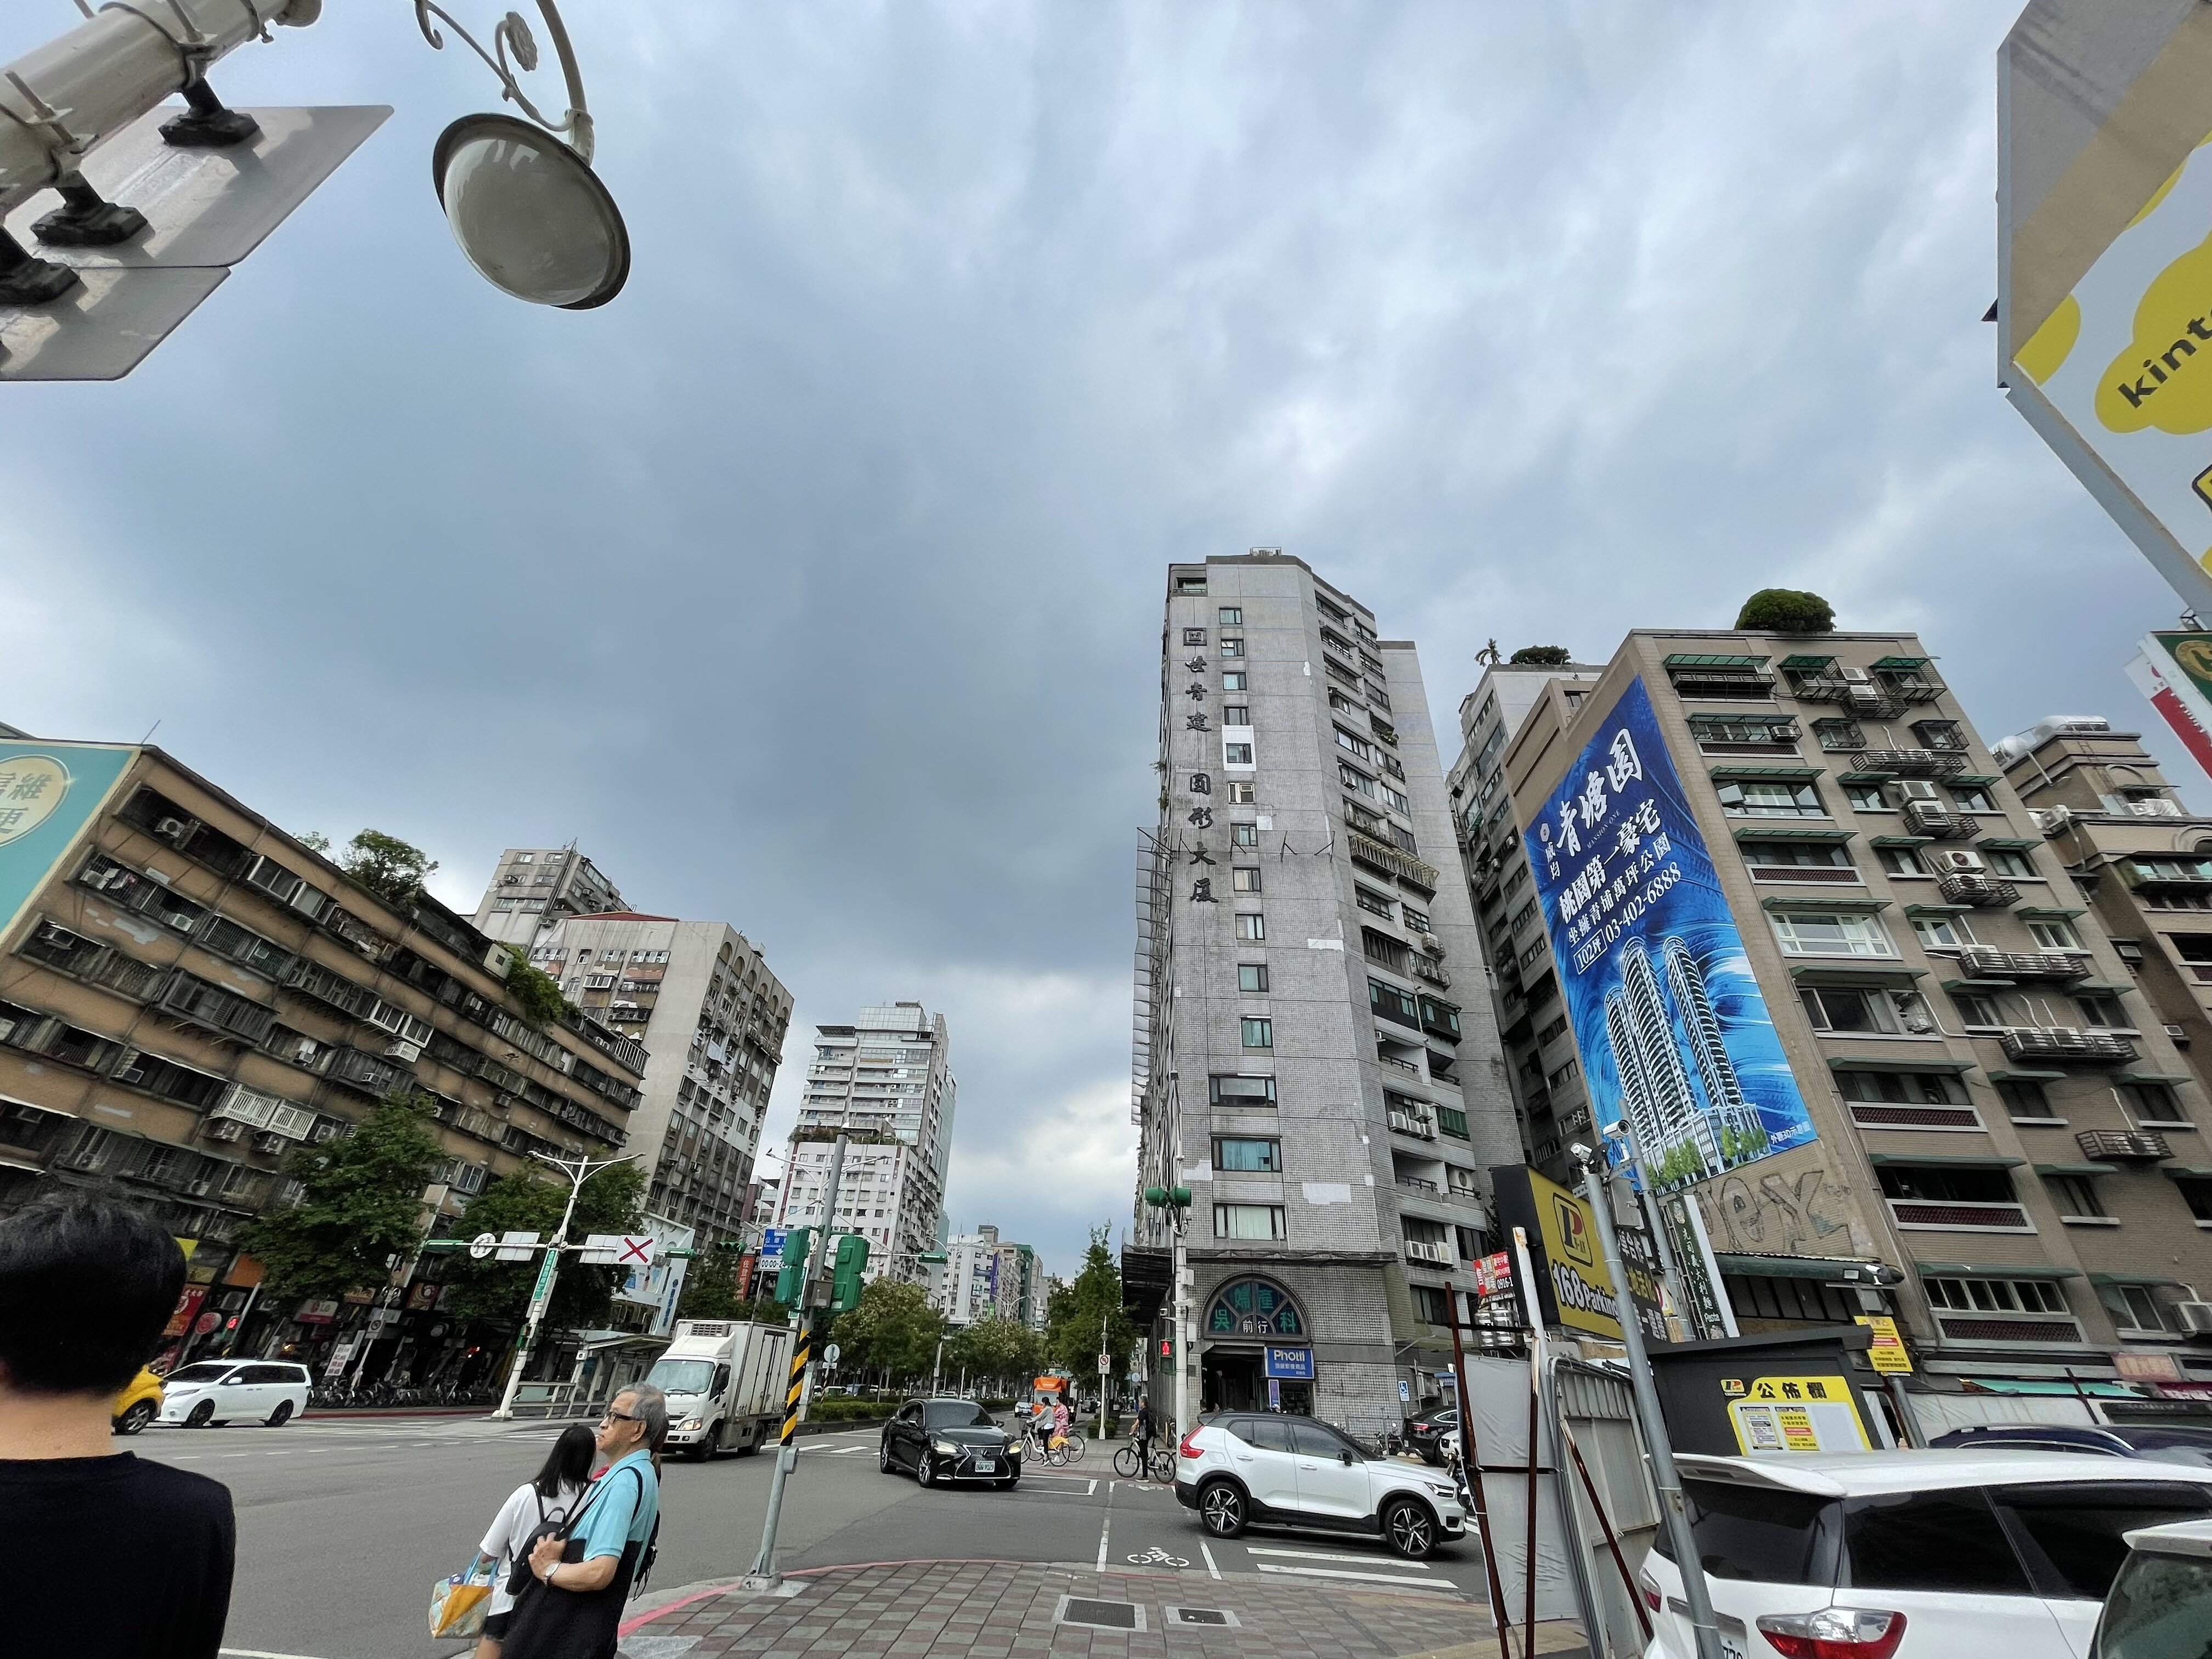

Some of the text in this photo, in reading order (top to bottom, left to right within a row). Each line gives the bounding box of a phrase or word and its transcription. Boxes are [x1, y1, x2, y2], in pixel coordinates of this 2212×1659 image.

[2118, 311, 2212, 409] kint
[1559, 798, 1661, 924] 桃園第一豪宅
[1568, 832, 1672, 945] 坐擁青埔萬坪公園
[1605, 861, 1681, 944] 03-402-6888
[1577, 935, 1602, 969] 102坪
[1757, 1382, 1827, 1399] 公佈欄
